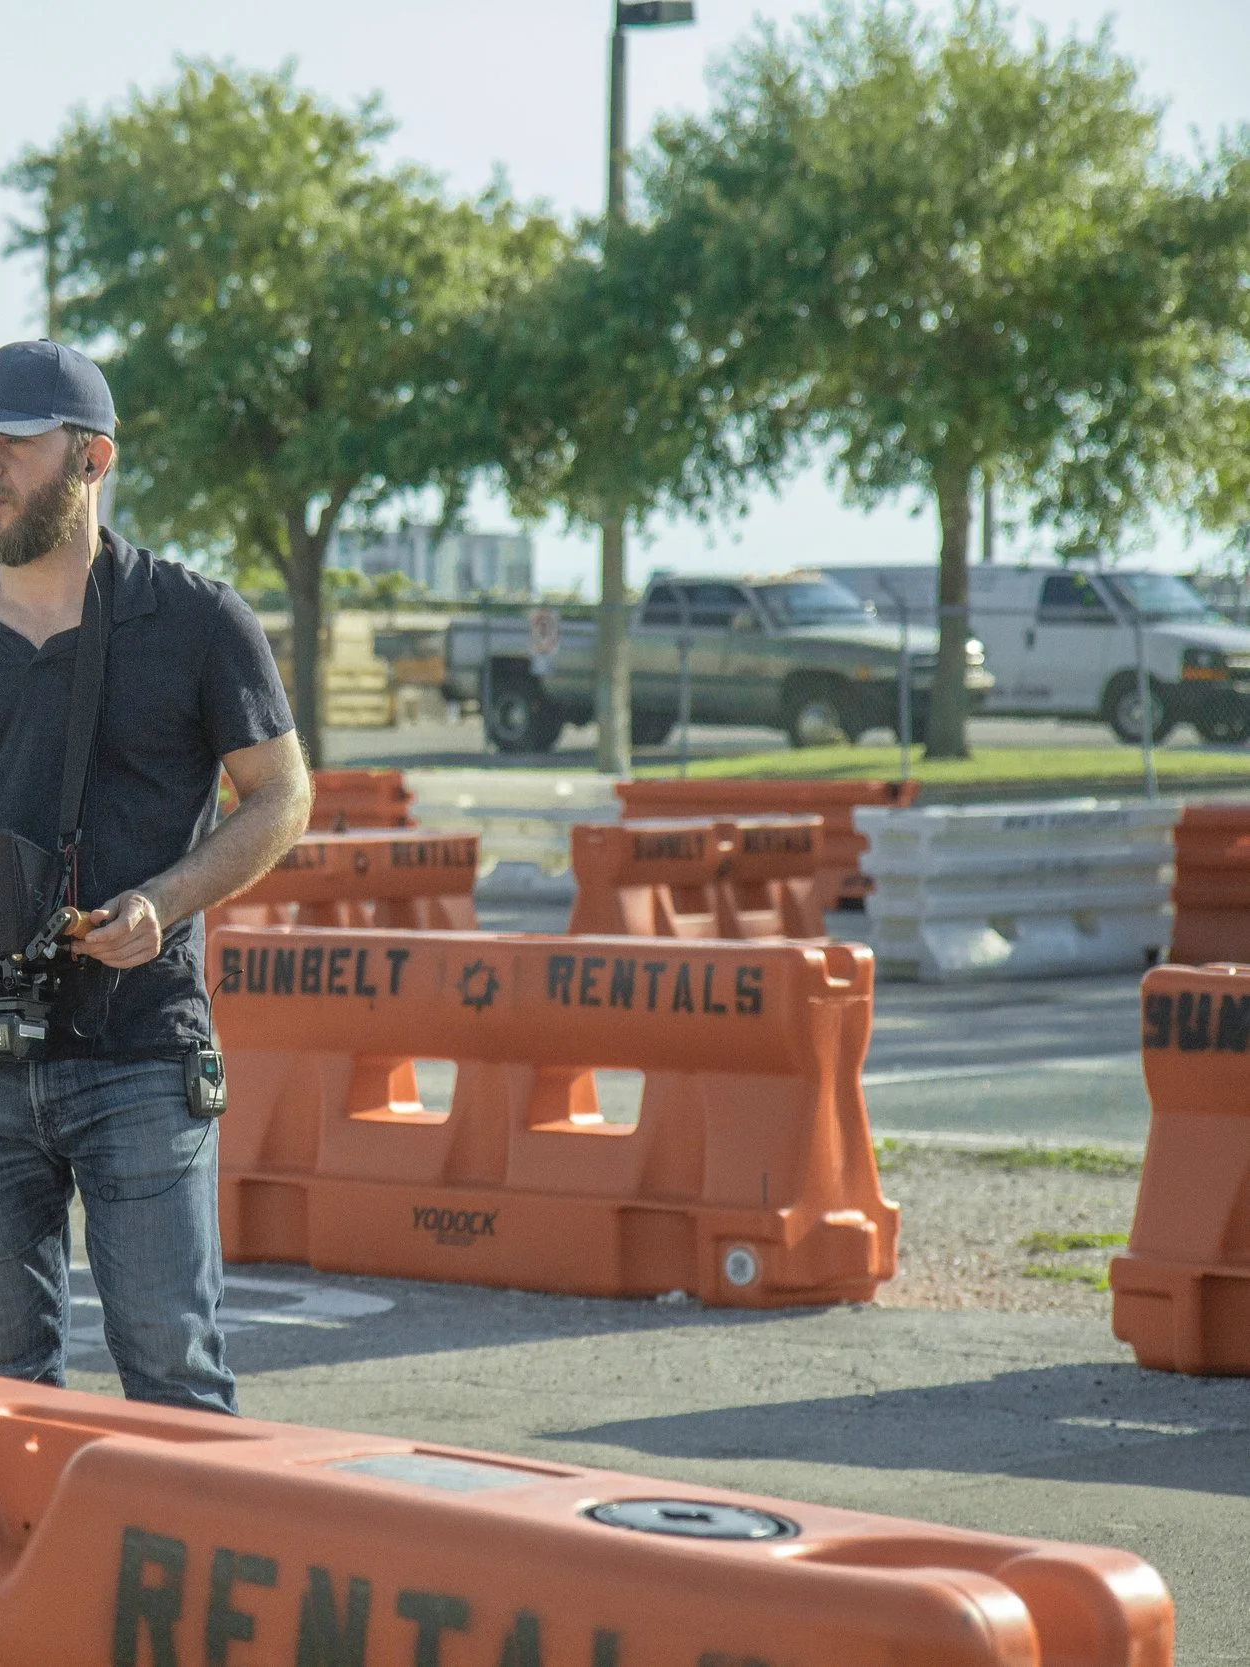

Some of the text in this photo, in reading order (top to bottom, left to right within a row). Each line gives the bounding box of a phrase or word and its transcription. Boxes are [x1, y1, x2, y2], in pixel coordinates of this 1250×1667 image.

[221, 945, 764, 1016] SUNBELT RENTALS
[412, 1206, 500, 1237] YODOCK
